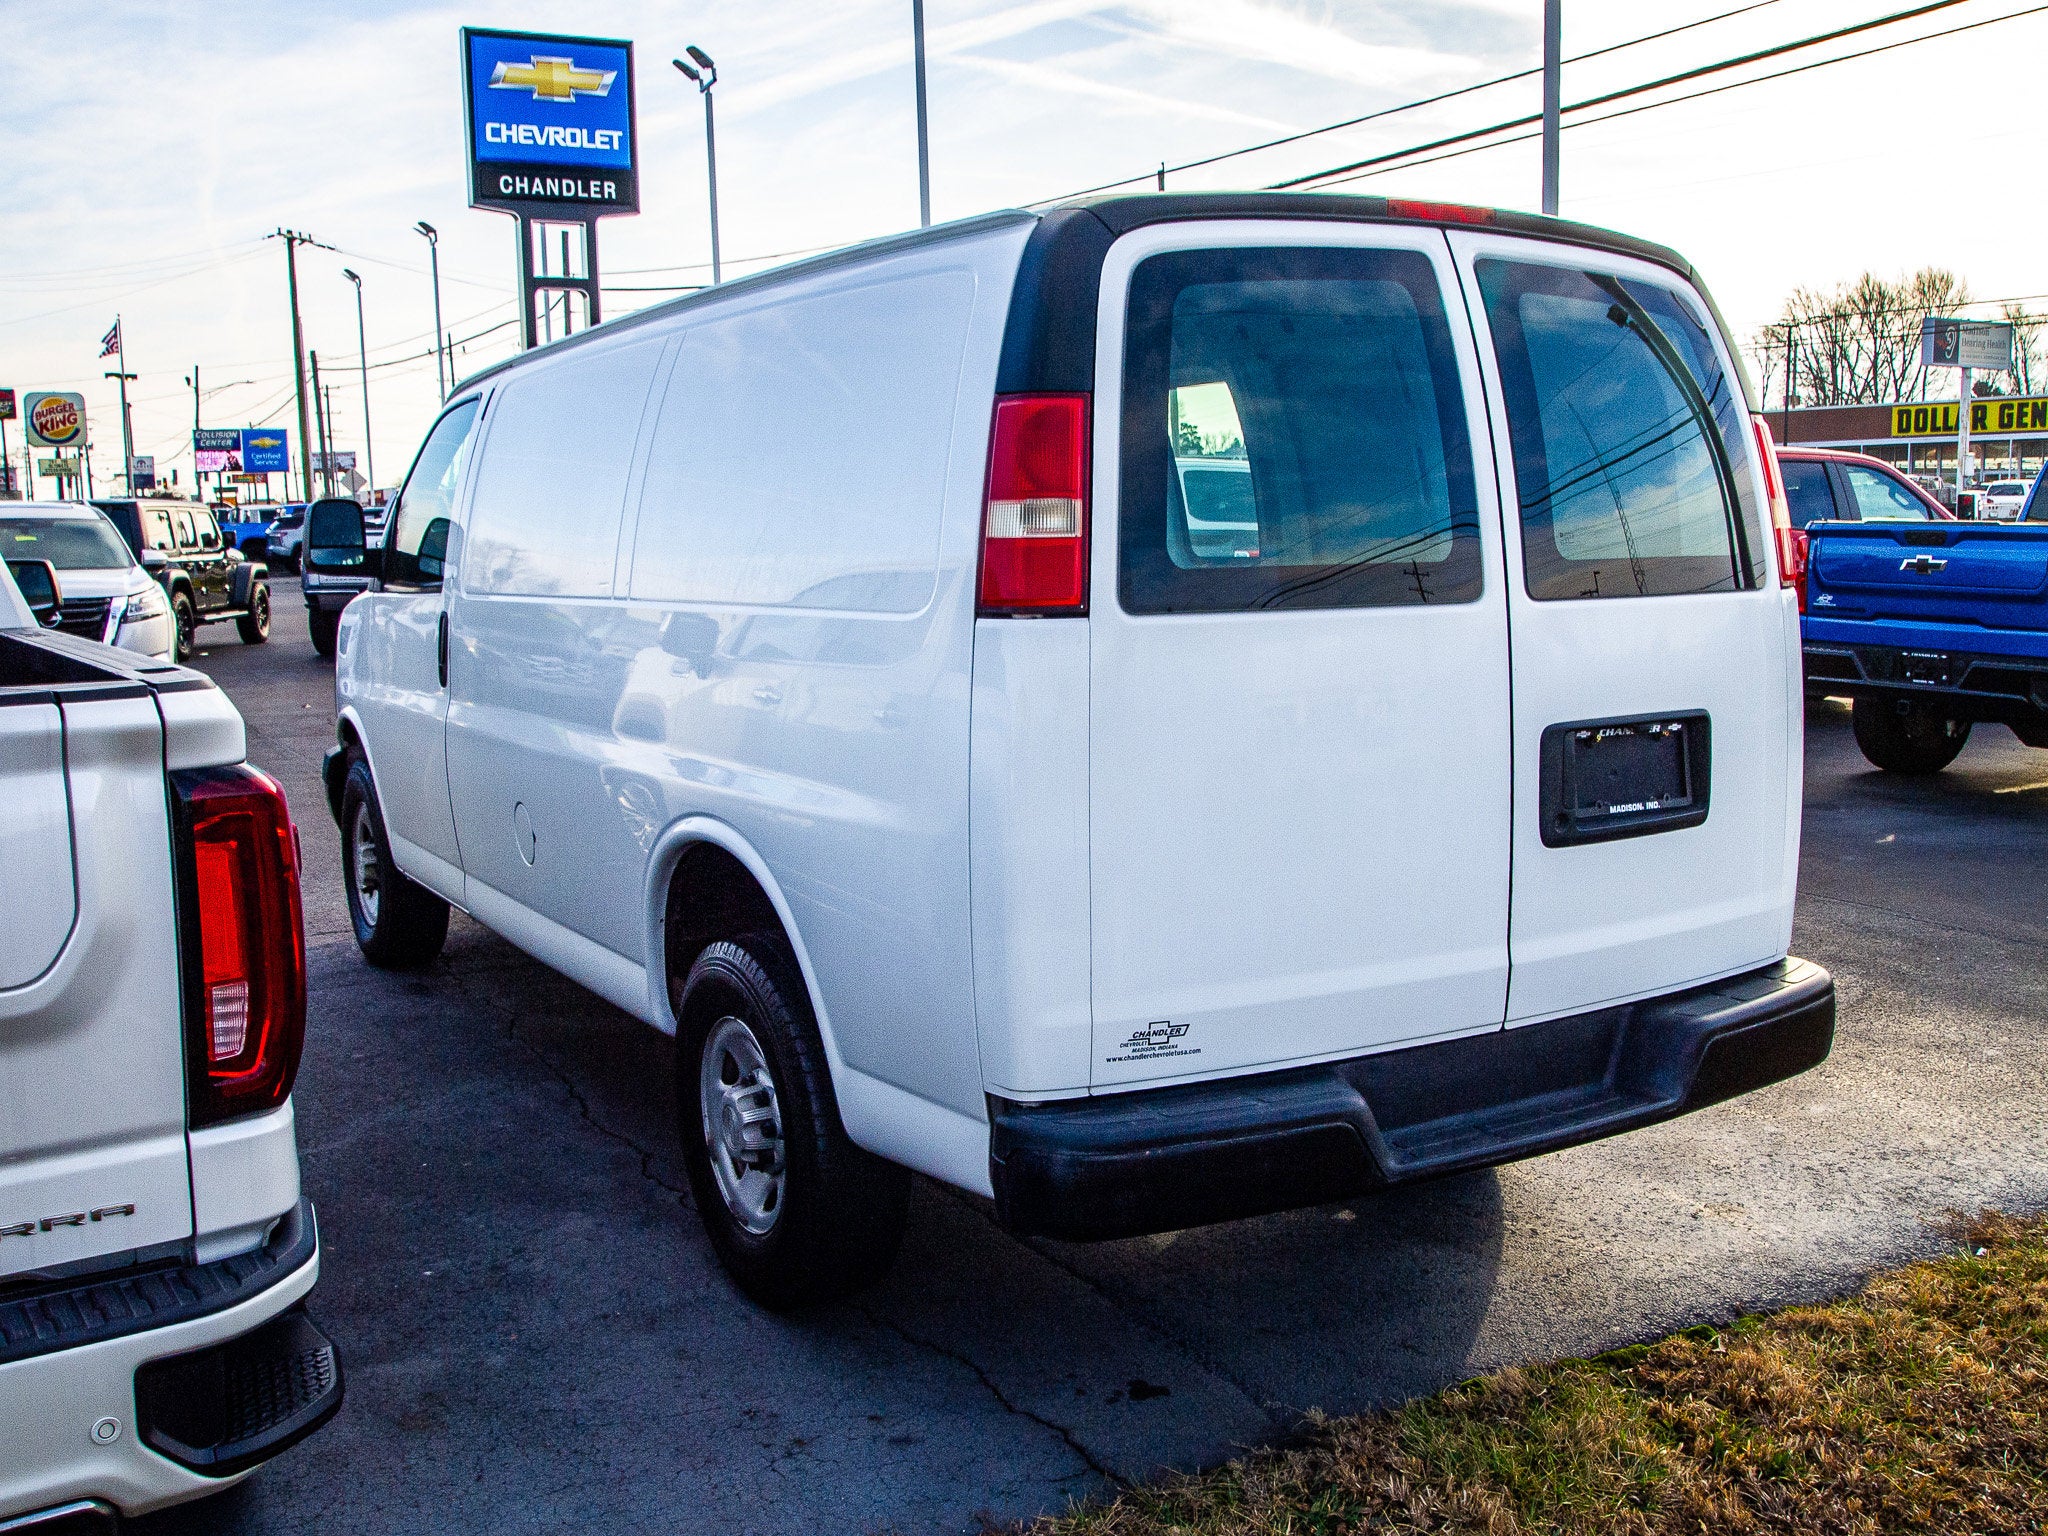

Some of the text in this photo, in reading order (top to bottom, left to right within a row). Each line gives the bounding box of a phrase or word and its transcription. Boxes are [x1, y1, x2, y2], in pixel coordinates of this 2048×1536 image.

[485, 122, 623, 150] CHEVROLET
[499, 174, 617, 200] CHANDLER
[1961, 338, 2007, 351] Hearing Health
[35, 402, 76, 421] BURGER
[38, 412, 79, 436] KING
[195, 430, 238, 439] COLLISION
[200, 438, 233, 447] CENTER
[251, 452, 282, 460] Certified
[1132, 1027, 1182, 1039] CHANDLER
[1119, 1040, 1148, 1049] CHEVROLET
[1106, 1048, 1201, 1062] www.chandlerchevroletusa.com
